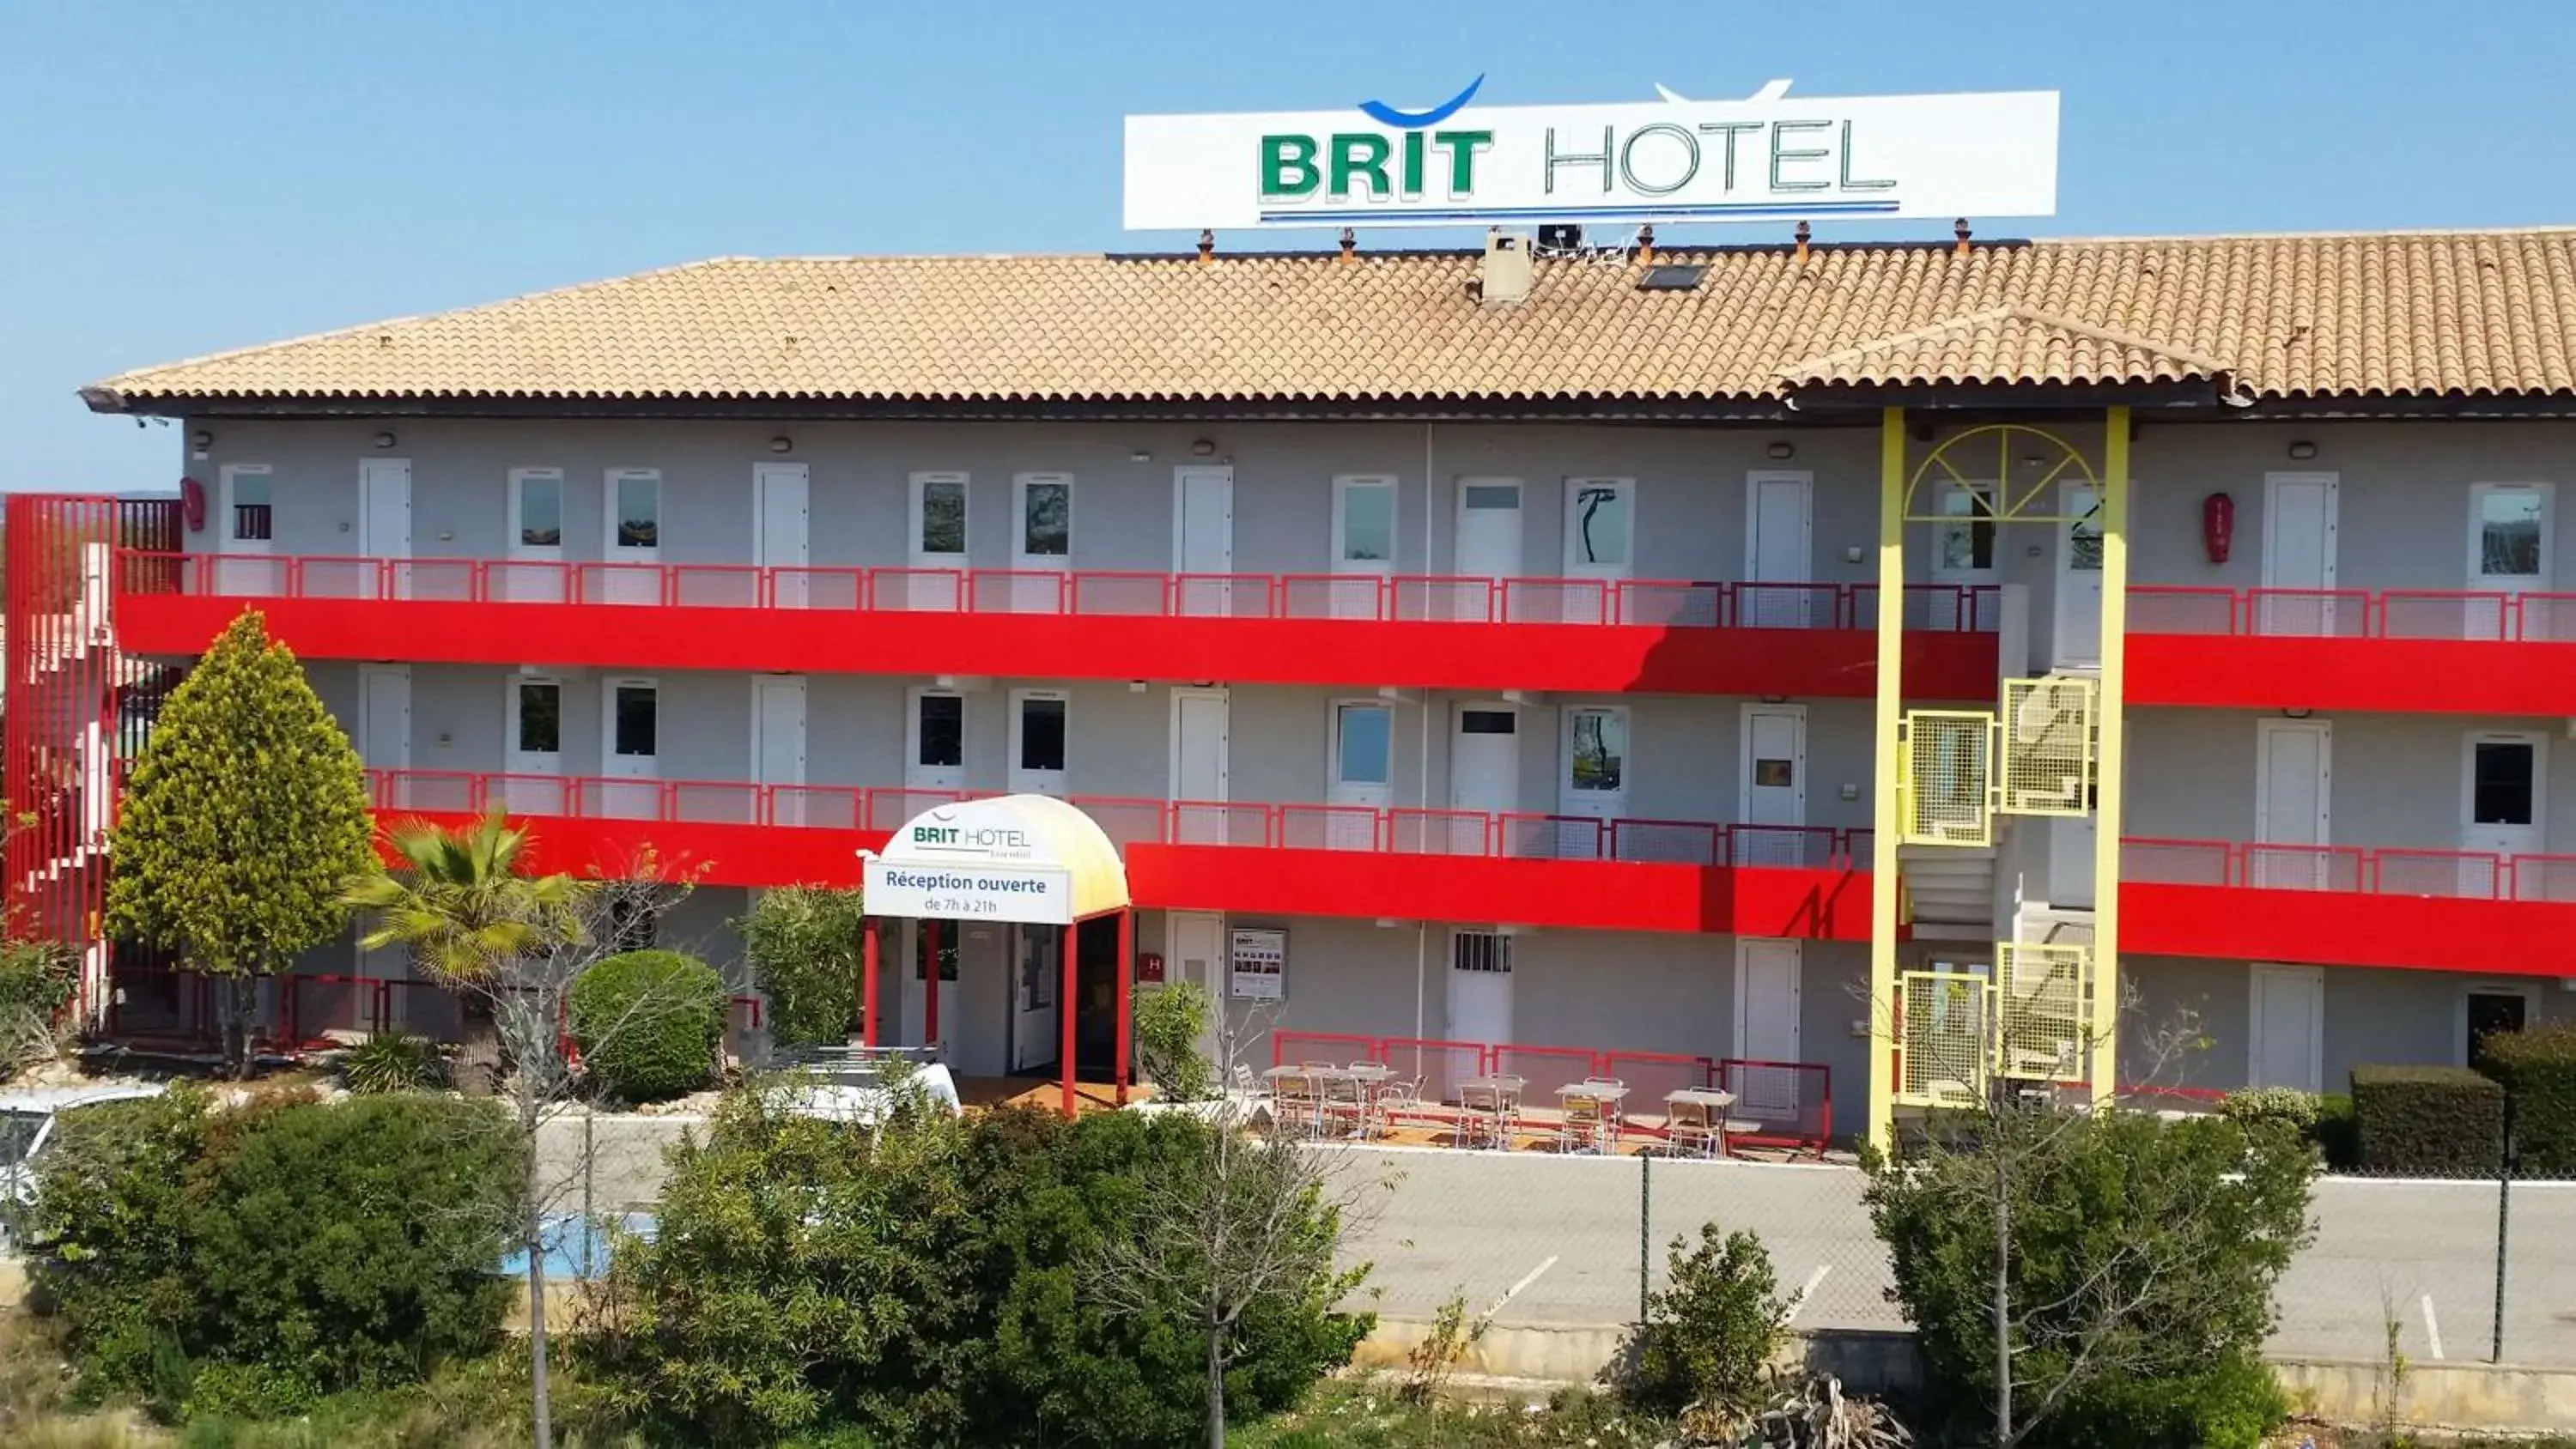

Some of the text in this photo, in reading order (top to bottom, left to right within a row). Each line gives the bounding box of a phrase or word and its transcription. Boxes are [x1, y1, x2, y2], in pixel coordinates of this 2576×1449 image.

[1261, 119, 1898, 195] BRIT HOTEL
[914, 827, 1031, 847] BRIT HOTEL
[886, 870, 1047, 894] Réception ouverte
[925, 899, 998, 913] de 7h à 21h
